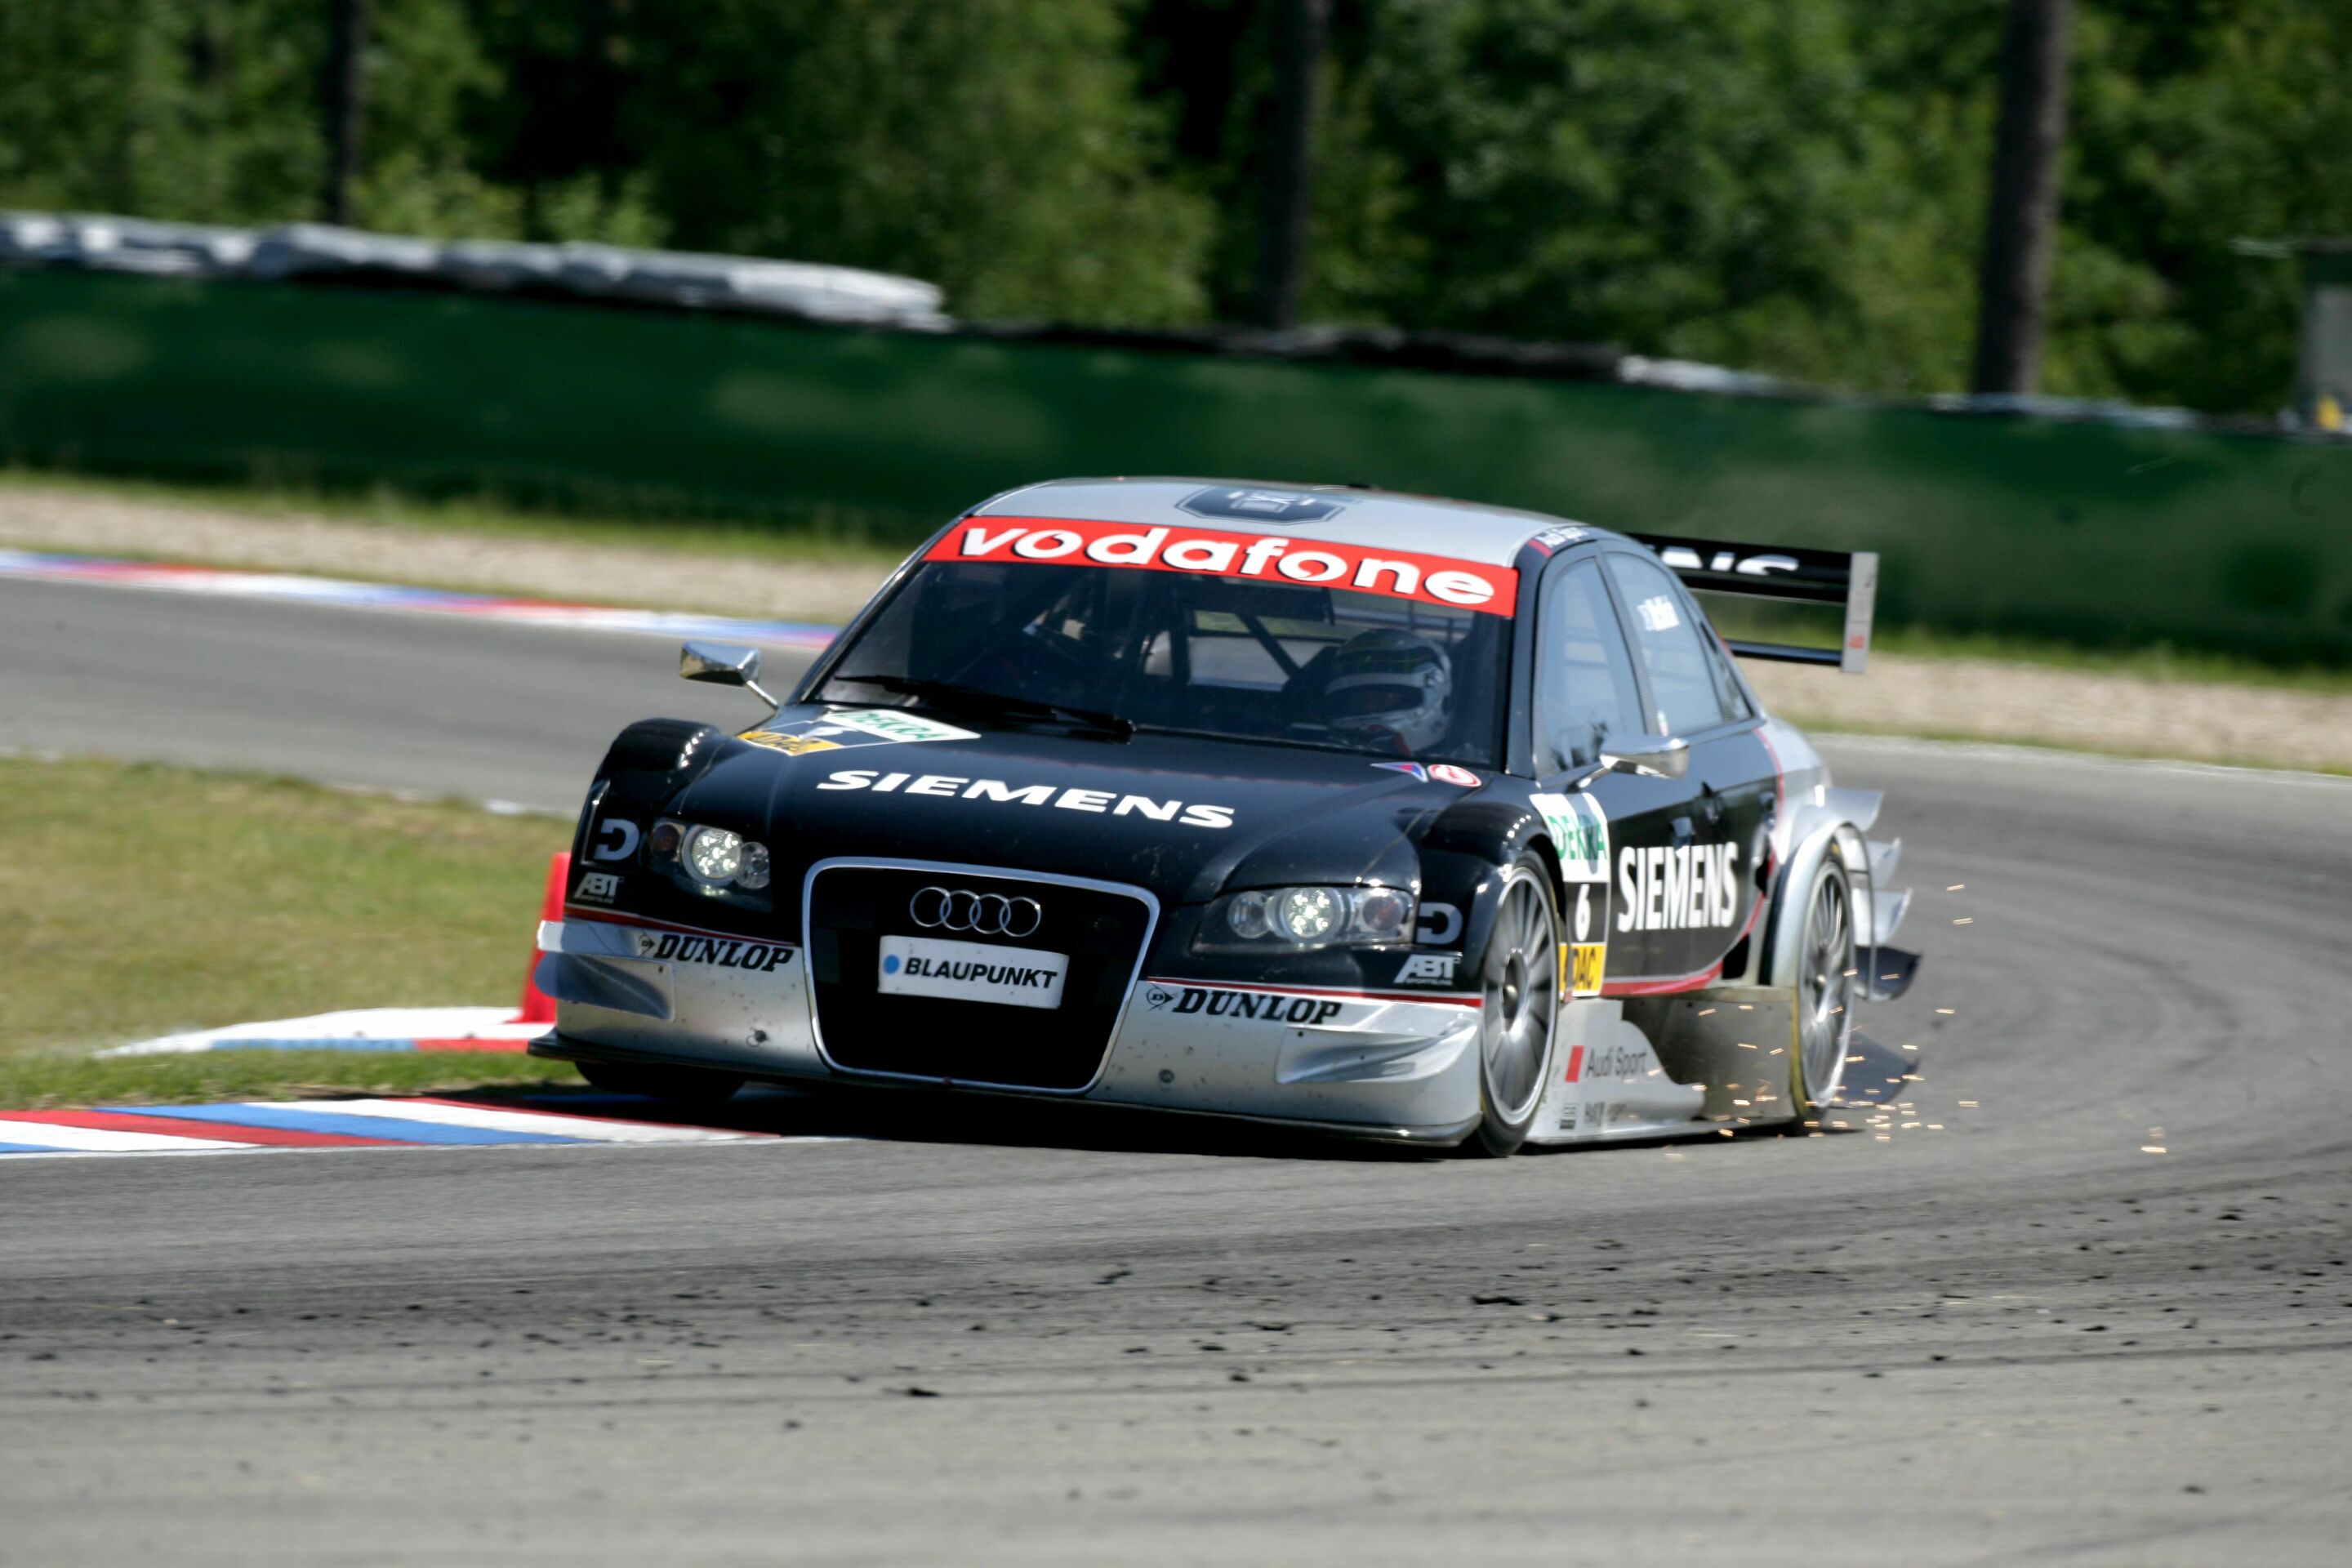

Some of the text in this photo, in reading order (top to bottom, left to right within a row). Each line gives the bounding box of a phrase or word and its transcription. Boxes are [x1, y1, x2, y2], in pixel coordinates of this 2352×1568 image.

[961, 528, 1494, 605] vodafone
[817, 770, 1235, 828] SIEMENS
[574, 872, 619, 899] ABT
[1617, 841, 1739, 933] SIEMENS
[1575, 883, 1592, 942] 6
[654, 933, 794, 972] DUNLOP
[1393, 954, 1454, 983] ABT
[904, 957, 1058, 989] BLAUPUNKT
[1172, 988, 1342, 1024] DUNLOP
